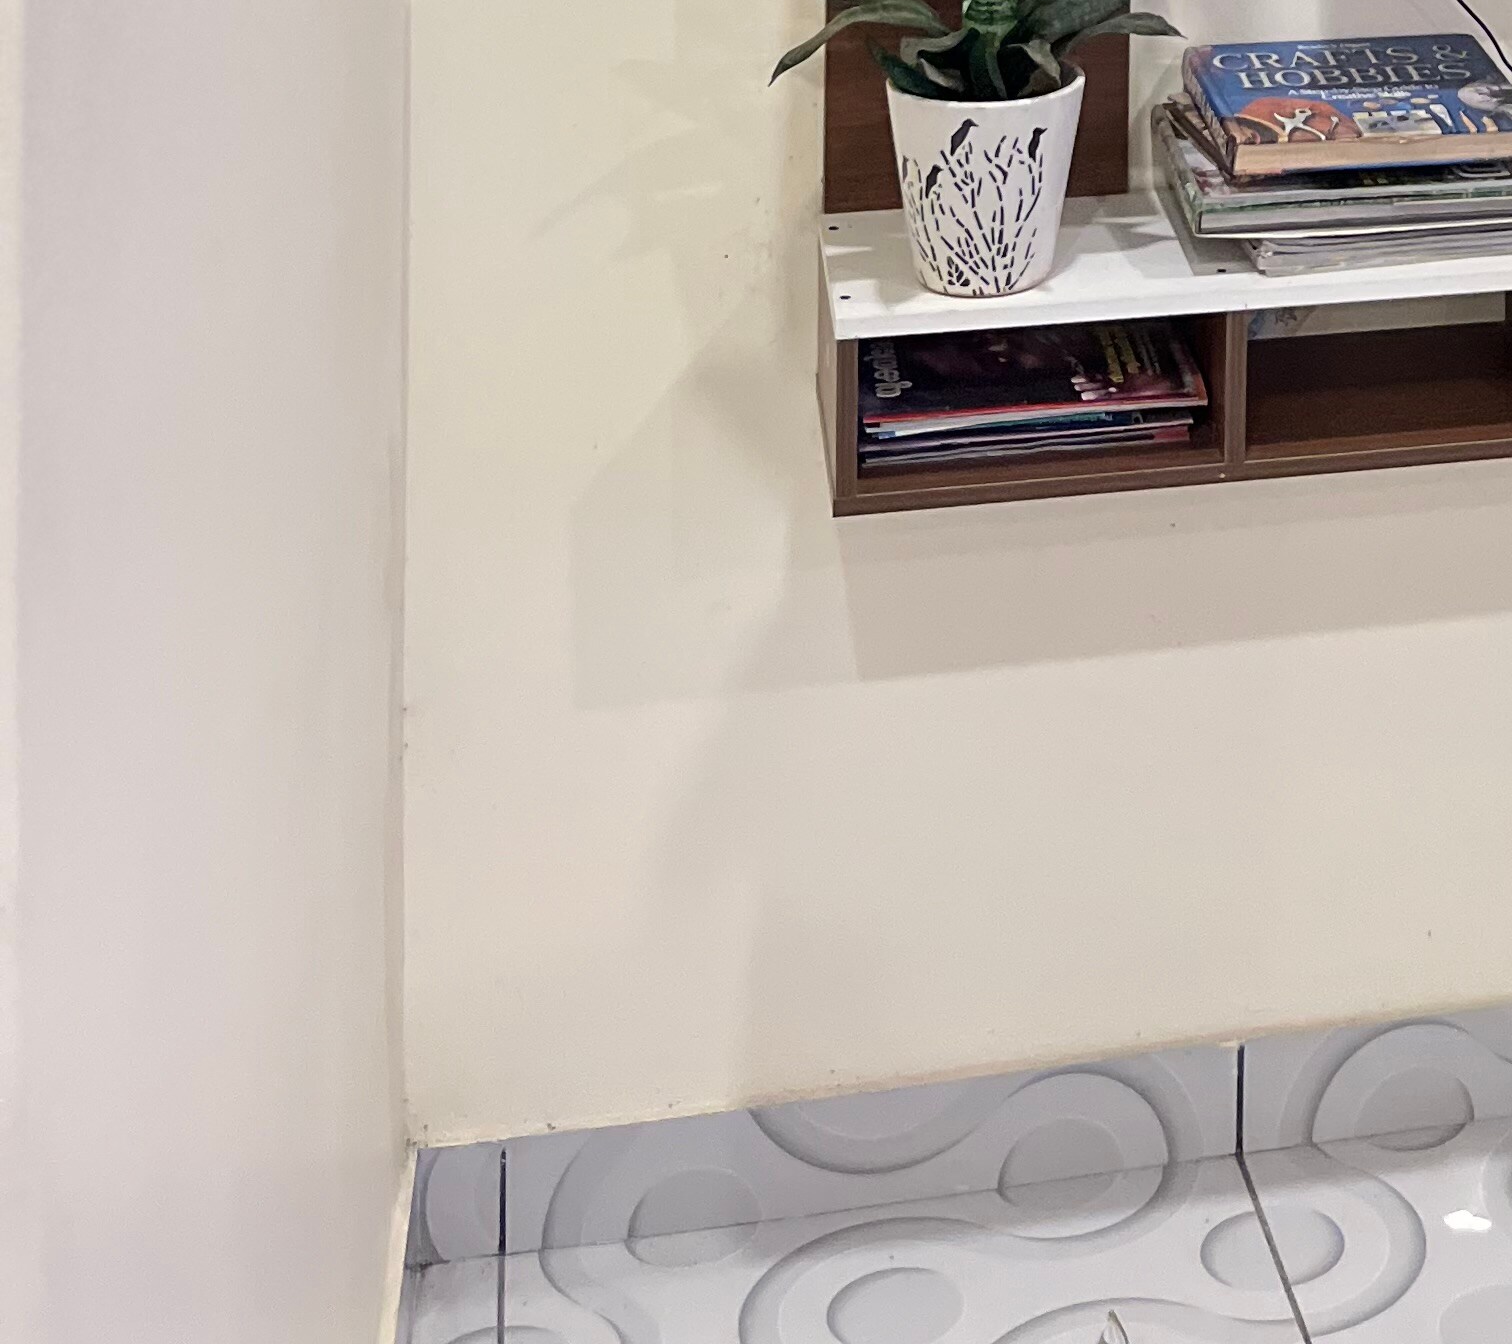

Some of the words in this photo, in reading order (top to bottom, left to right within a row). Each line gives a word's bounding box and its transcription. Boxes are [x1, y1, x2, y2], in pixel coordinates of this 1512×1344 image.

[1212, 46, 1420, 71] CRAFTS
[1432, 43, 1468, 61] &
[1235, 61, 1472, 89] HOBBIES
